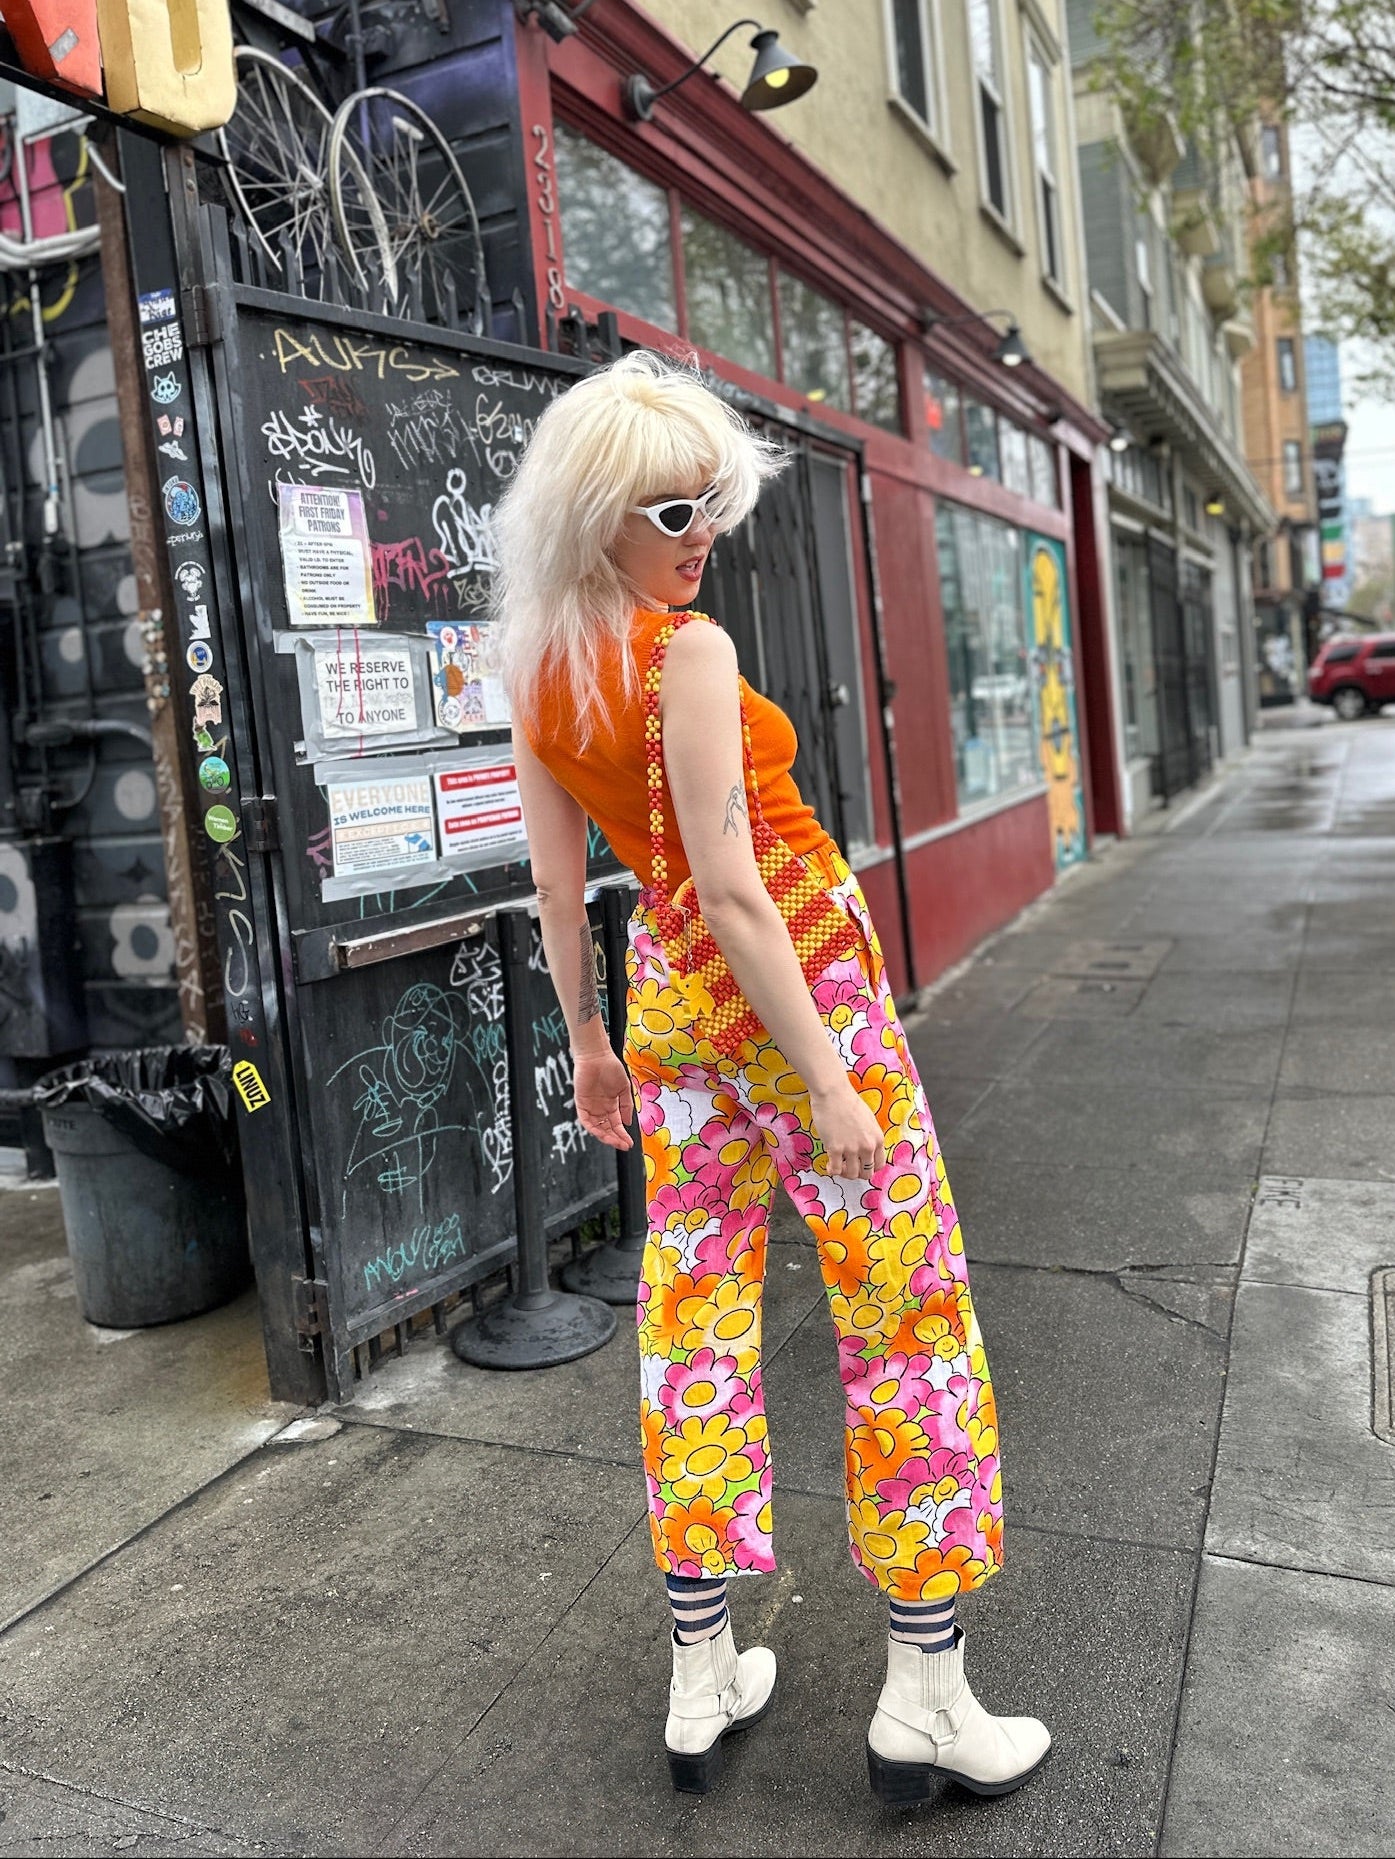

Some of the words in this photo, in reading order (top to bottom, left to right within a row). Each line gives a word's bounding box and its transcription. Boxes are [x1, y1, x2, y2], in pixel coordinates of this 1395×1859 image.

[532, 124, 564, 309] 2318
[142, 322, 180, 344] CHE
[143, 337, 182, 357] GOBS
[145, 347, 184, 369] CREW
[301, 493, 340, 507] ATTENTION!
[299, 506, 318, 518] FIRST
[320, 507, 344, 520] FRIDAY
[308, 519, 341, 533] PATRONS
[326, 662, 347, 675] WE
[350, 661, 406, 674] RESERVE
[326, 680, 350, 693] THE
[354, 678, 389, 692] RIGHT
[393, 677, 409, 689] TO
[337, 711, 354, 725] TO
[358, 708, 406, 724] ANYONE
[331, 780, 429, 814] EVERYONE
[334, 817, 347, 826] IS
[349, 806, 403, 821] WELCOME
[404, 805, 431, 814] HERE
[236, 1066, 266, 1109] LINUZ
